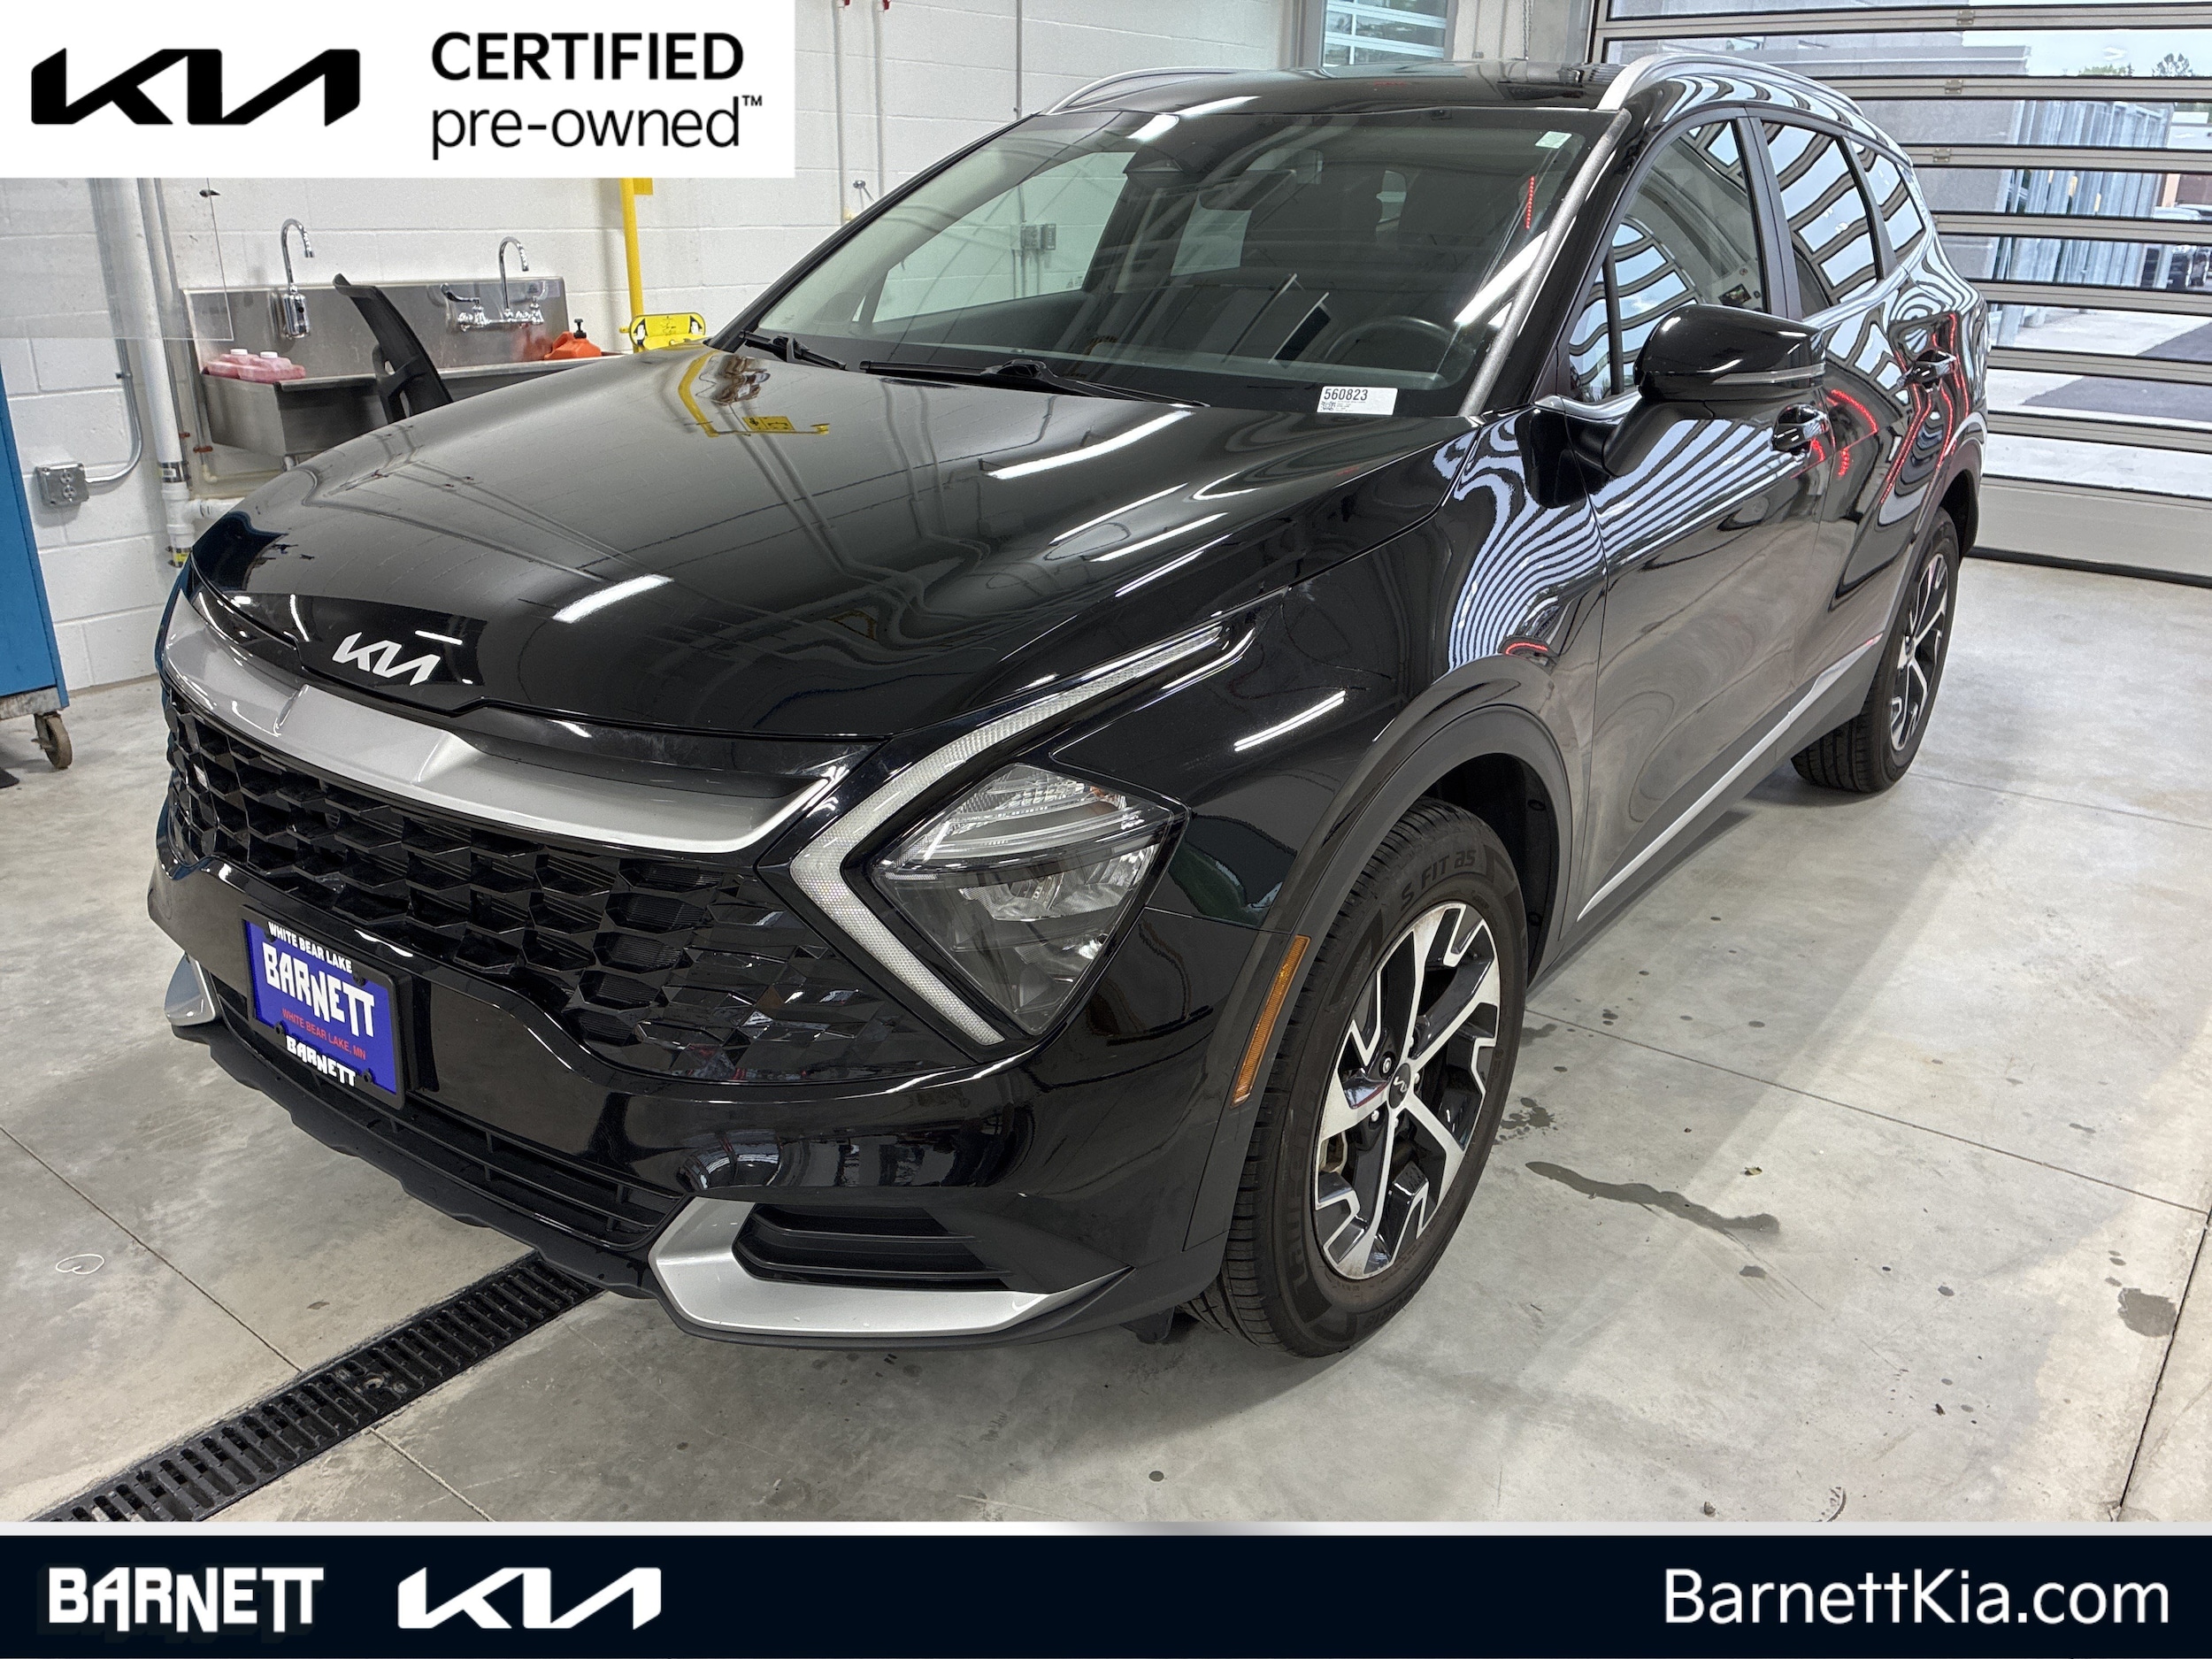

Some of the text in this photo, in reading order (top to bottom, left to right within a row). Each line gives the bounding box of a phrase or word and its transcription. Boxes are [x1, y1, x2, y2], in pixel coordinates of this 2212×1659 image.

[1324, 388, 1369, 401] 560823
[1421, 856, 1450, 890] FIT
[267, 921, 353, 974] WHITE BEAR LAKE
[262, 942, 375, 1038] BARNETT
[282, 1008, 366, 1061] WHITE BEAR LAKE, MN
[286, 1034, 356, 1087] BARNETT
